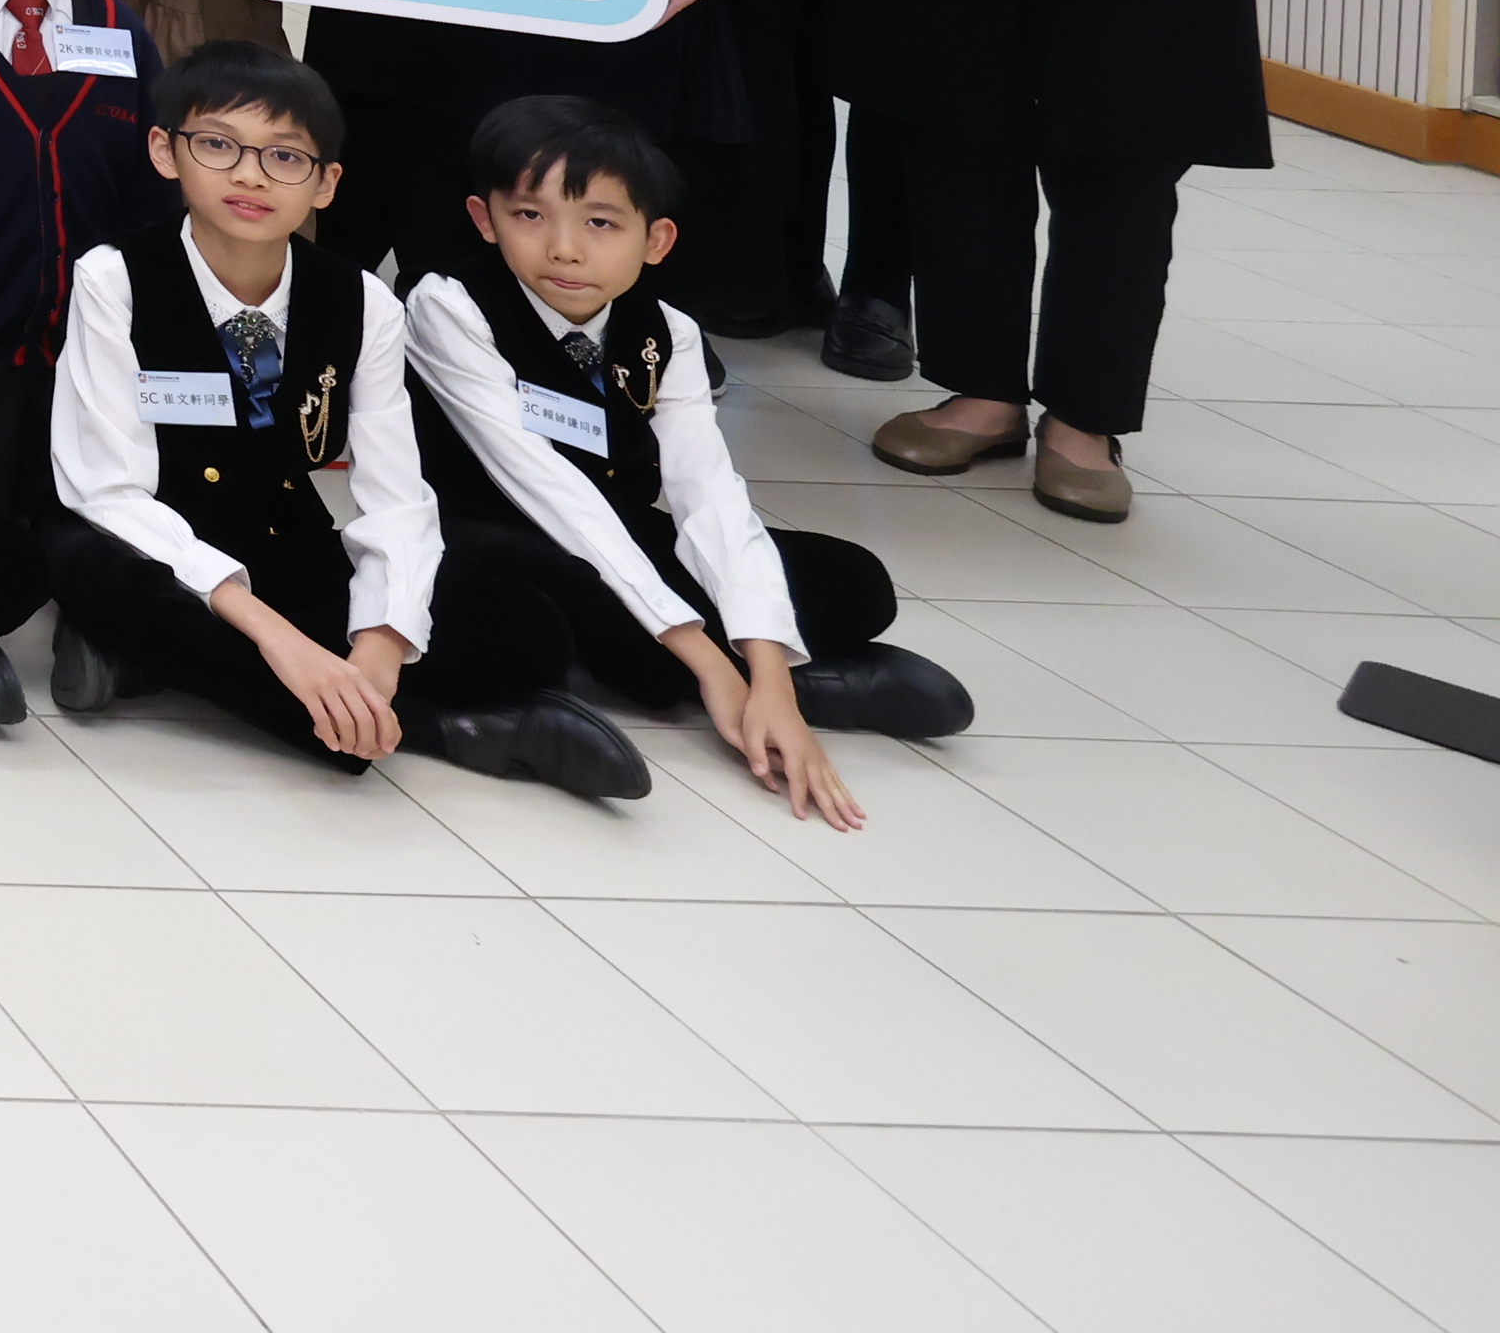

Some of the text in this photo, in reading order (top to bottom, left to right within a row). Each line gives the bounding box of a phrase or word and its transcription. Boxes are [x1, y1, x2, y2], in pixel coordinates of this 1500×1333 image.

[59, 43, 74, 54] 2K
[140, 392, 159, 404] 5C
[522, 401, 540, 416] 3C
